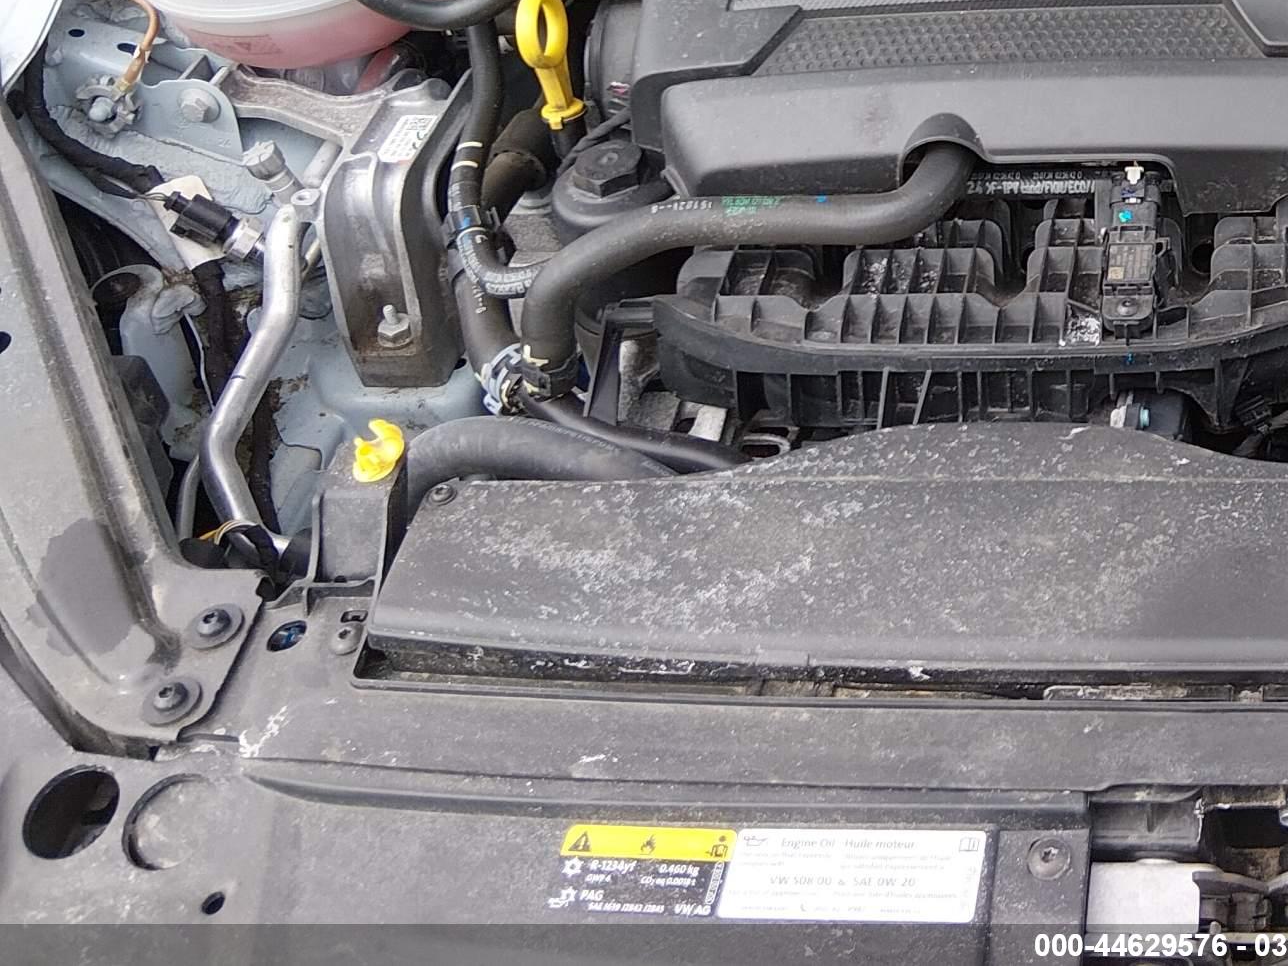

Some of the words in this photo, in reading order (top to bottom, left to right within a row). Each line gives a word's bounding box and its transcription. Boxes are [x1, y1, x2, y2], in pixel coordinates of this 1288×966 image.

[781, 837, 817, 850] Engine
[820, 837, 835, 848] Oil
[845, 838, 872, 848] Huile
[875, 839, 916, 849] moteur
[589, 859, 637, 876] R-1234yf
[658, 864, 686, 874] 0.460
[687, 865, 700, 876] kg
[580, 889, 605, 901] PAG
[674, 904, 694, 915] VW
[694, 905, 711, 915] AG
